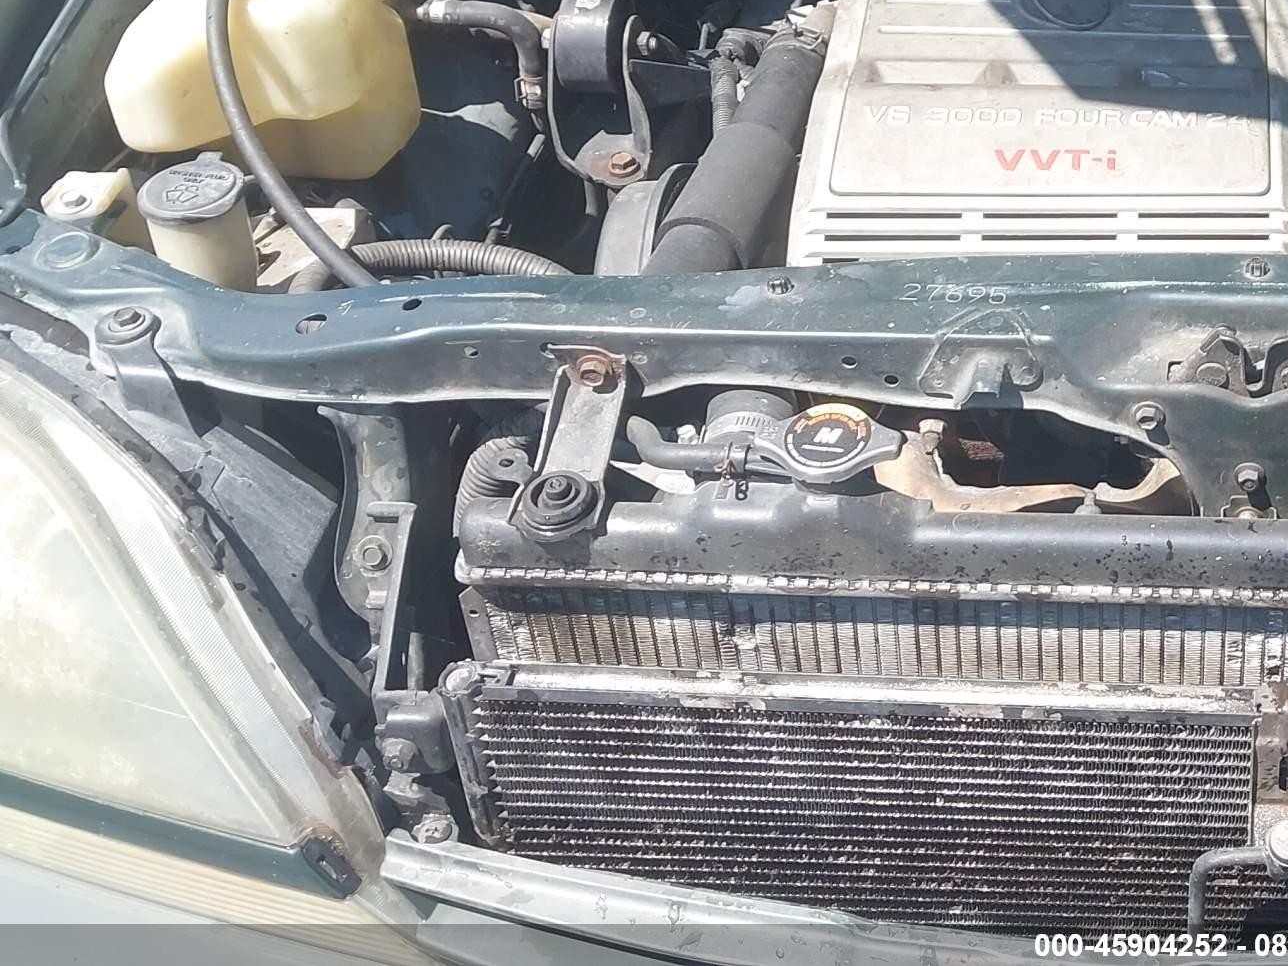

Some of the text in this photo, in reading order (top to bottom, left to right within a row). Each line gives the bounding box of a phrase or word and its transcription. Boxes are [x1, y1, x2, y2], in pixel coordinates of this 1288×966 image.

[864, 105, 911, 125] V6
[922, 106, 1023, 127] 3000
[1035, 108, 1125, 128] FOUR
[1130, 110, 1198, 129] CAM
[994, 149, 1117, 171] VVT-i
[899, 283, 1009, 305] 27695
